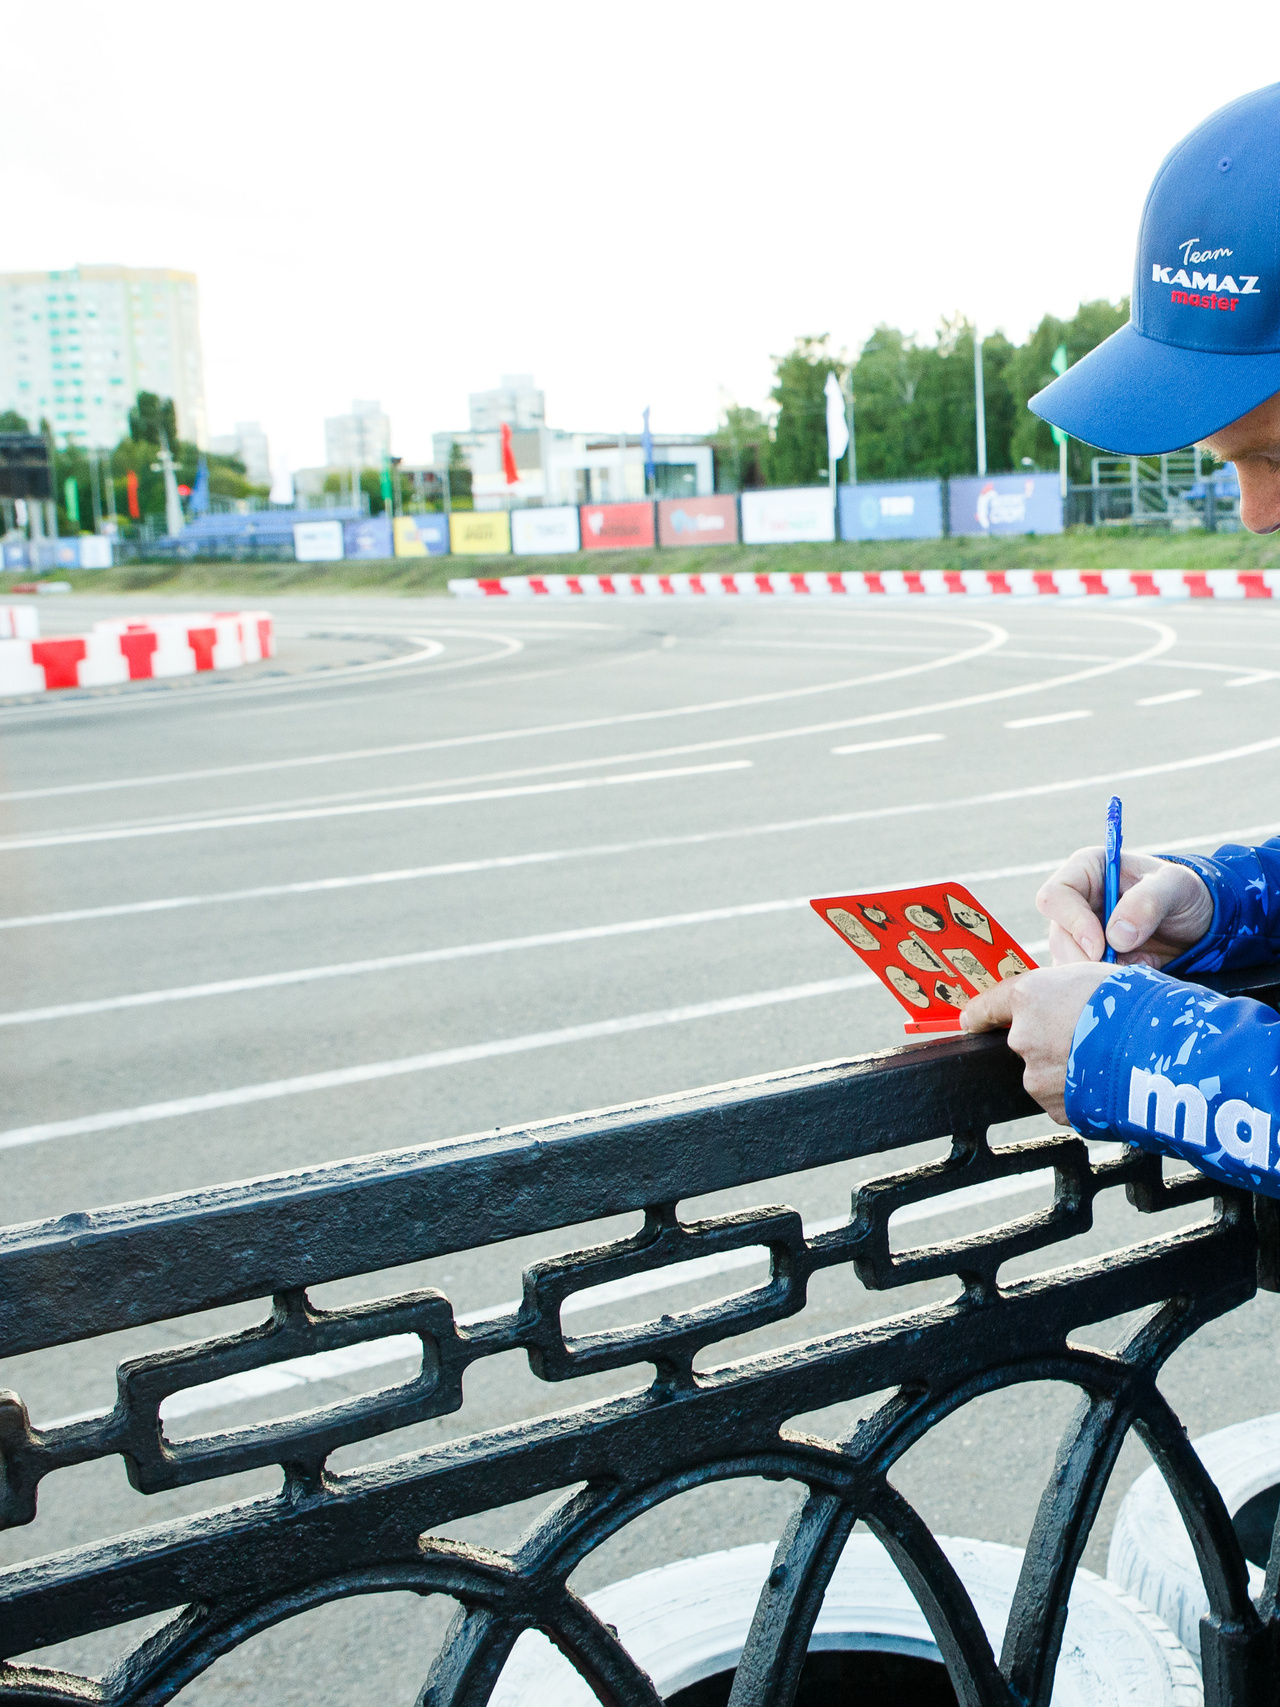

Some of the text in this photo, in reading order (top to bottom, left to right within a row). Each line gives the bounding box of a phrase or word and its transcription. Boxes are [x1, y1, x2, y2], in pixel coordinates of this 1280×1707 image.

[1178, 238, 1233, 265] Team
[1152, 264, 1261, 294] KAMAZ
[1171, 290, 1239, 311] master
